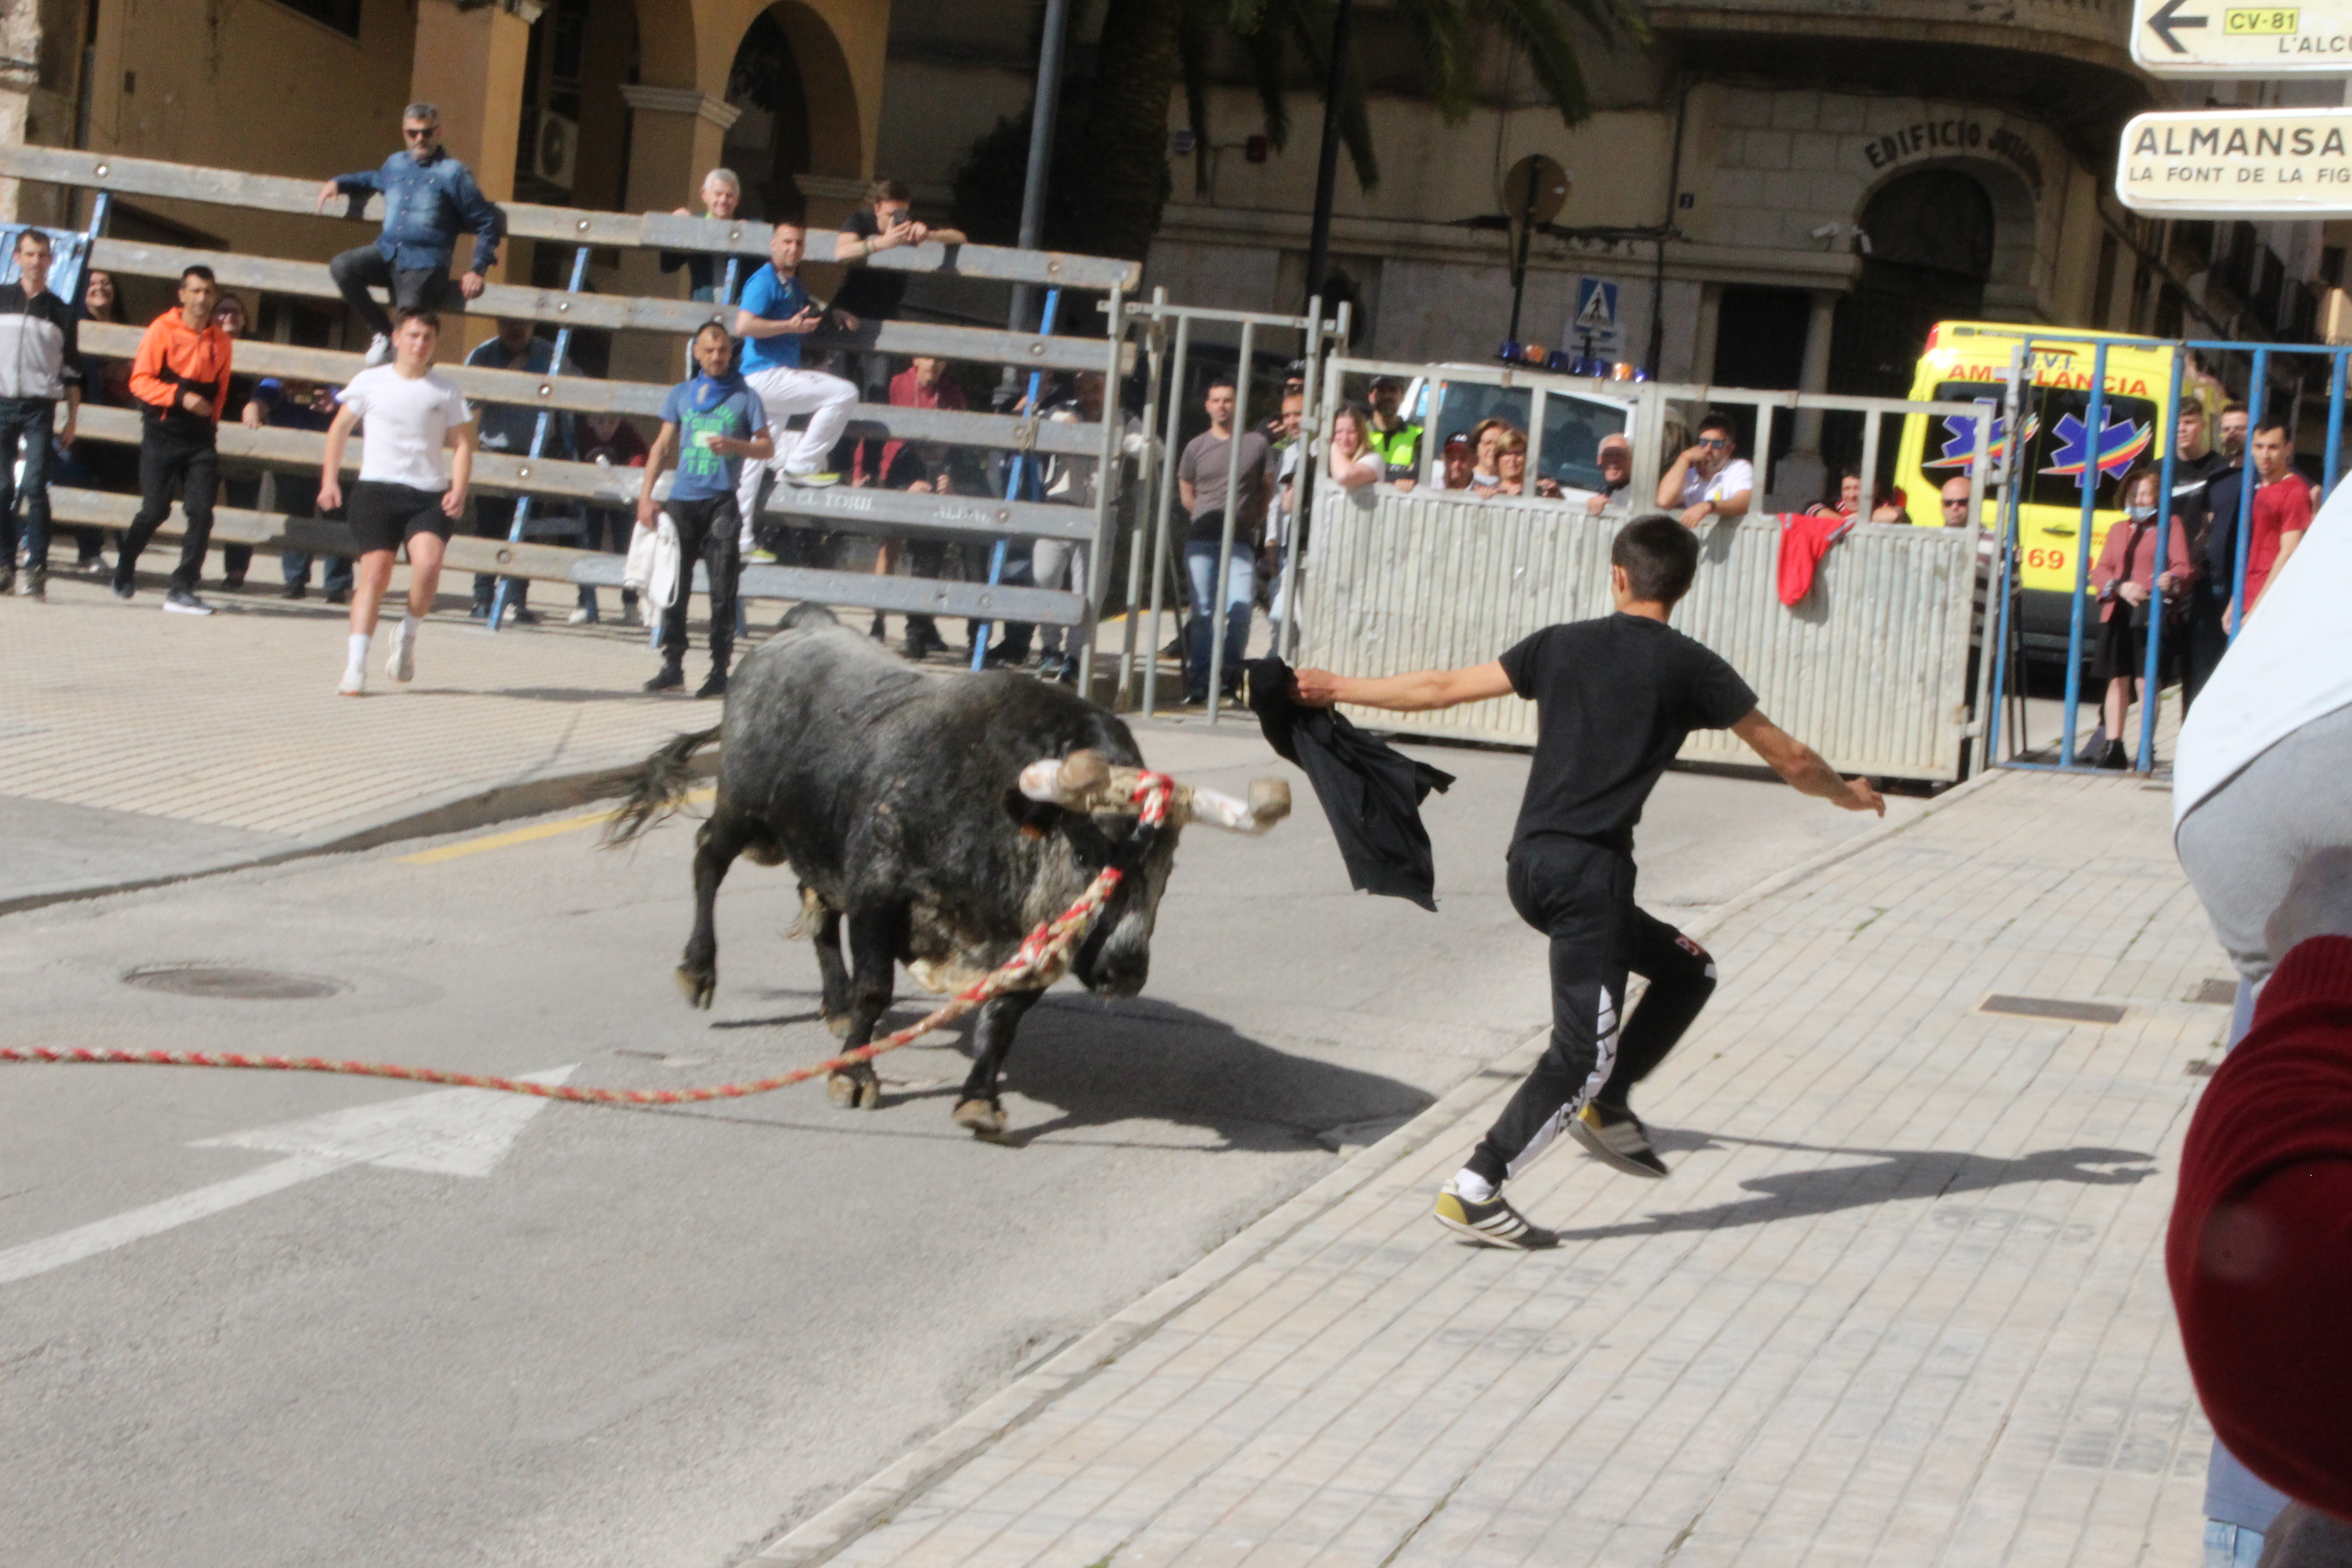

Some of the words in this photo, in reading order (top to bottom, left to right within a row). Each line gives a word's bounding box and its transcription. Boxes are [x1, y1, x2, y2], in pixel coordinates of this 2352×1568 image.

[2230, 12, 2296, 30] CV-81
[1864, 119, 1981, 168] EDIFICIO
[2133, 127, 2346, 157] ALMANSA
[2130, 167, 2153, 181] LA
[2166, 167, 2225, 182] FONT
[2237, 167, 2265, 182] DE
[2278, 167, 2303, 183] LA
[1947, 364, 2147, 396] AMLANCIA
[2028, 548, 2064, 570] 69
